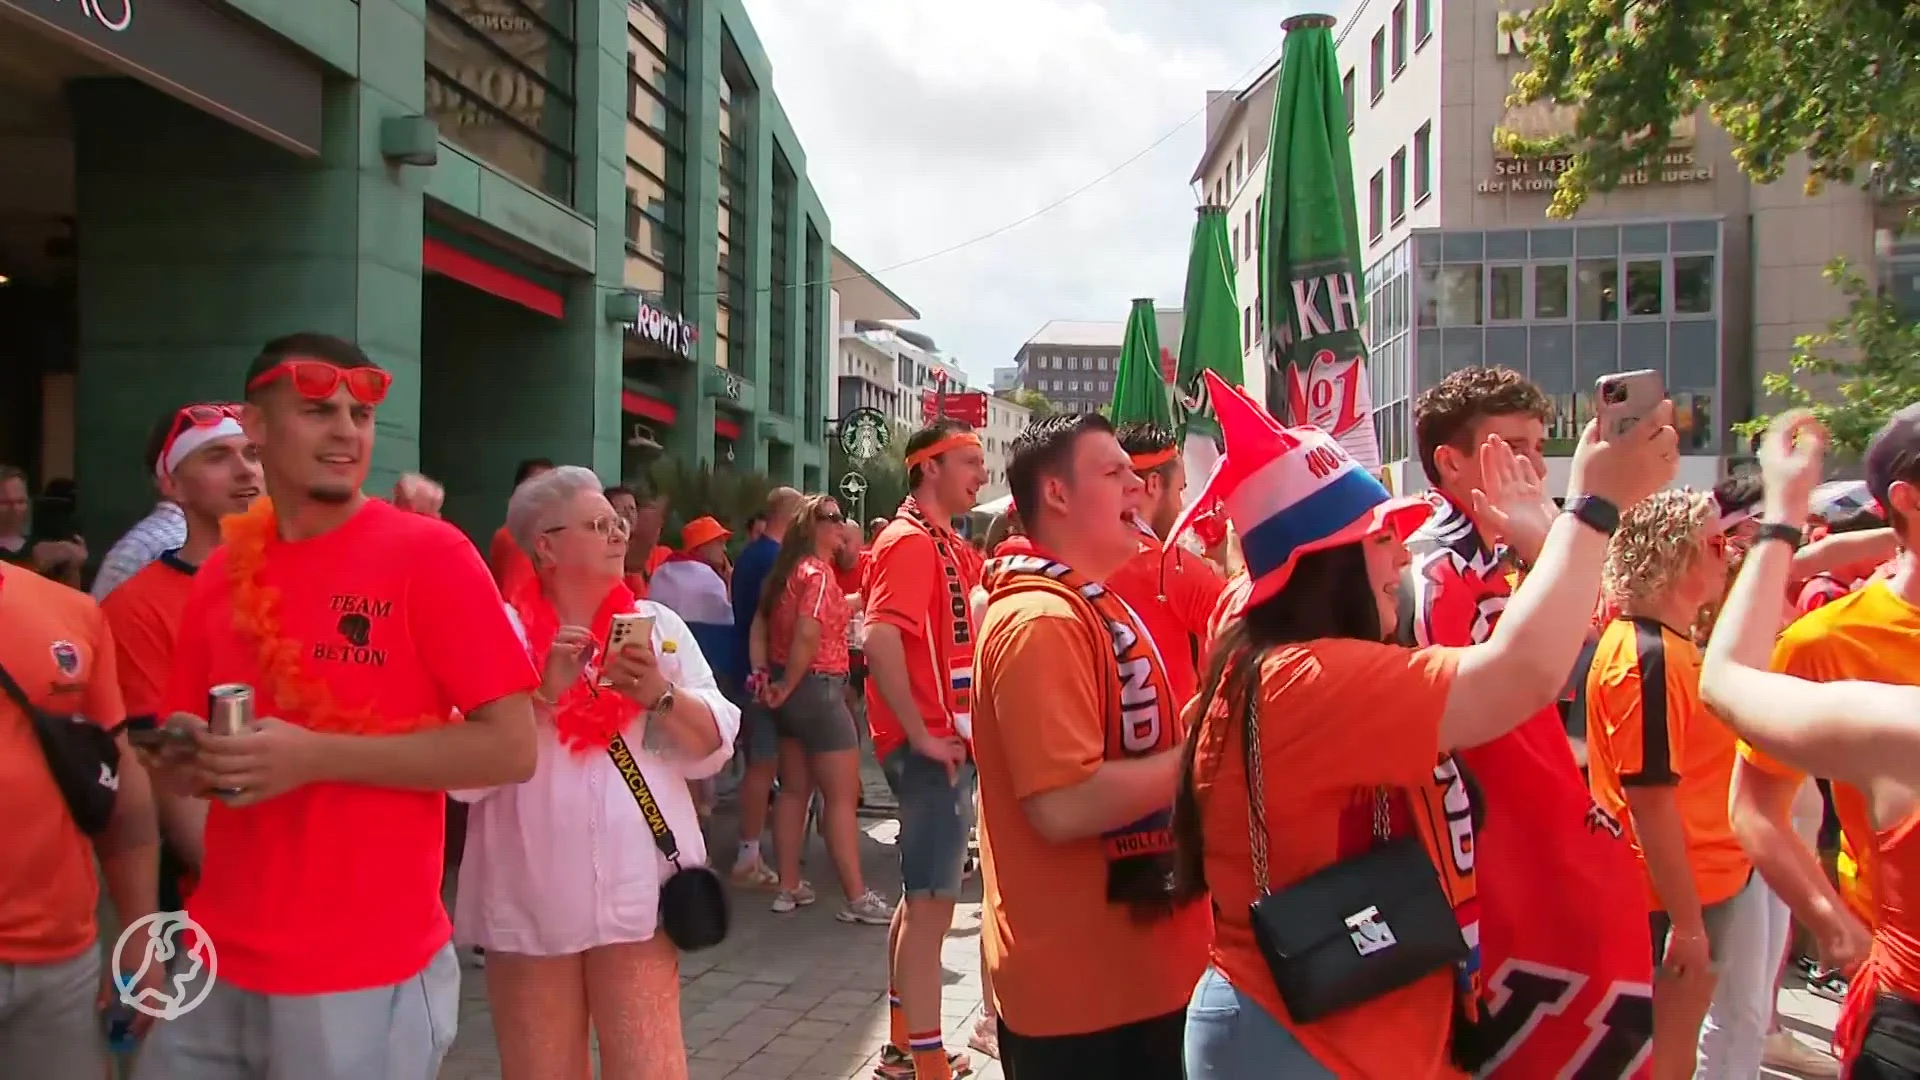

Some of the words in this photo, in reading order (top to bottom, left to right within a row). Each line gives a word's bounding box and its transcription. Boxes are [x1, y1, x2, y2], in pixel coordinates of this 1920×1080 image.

[1478, 180, 1504, 193] der
[330, 594, 392, 617] TEAM
[313, 643, 387, 667] BETON
